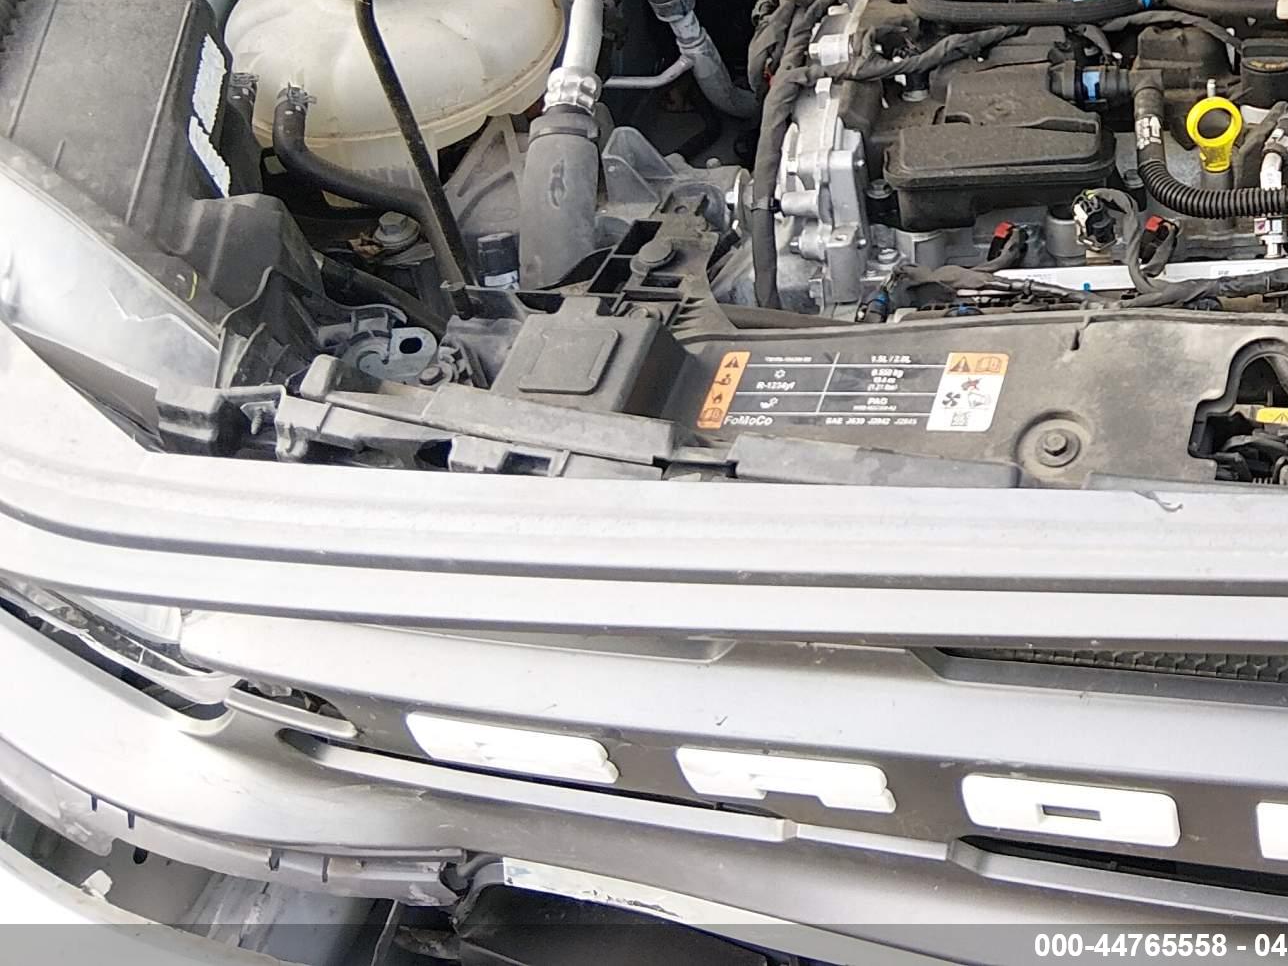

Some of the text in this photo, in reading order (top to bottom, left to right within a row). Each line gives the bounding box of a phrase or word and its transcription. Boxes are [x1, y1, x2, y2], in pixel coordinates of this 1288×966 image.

[867, 397, 888, 405] PAG
[723, 415, 774, 426] FoMoCo
[825, 417, 843, 425] SAE
